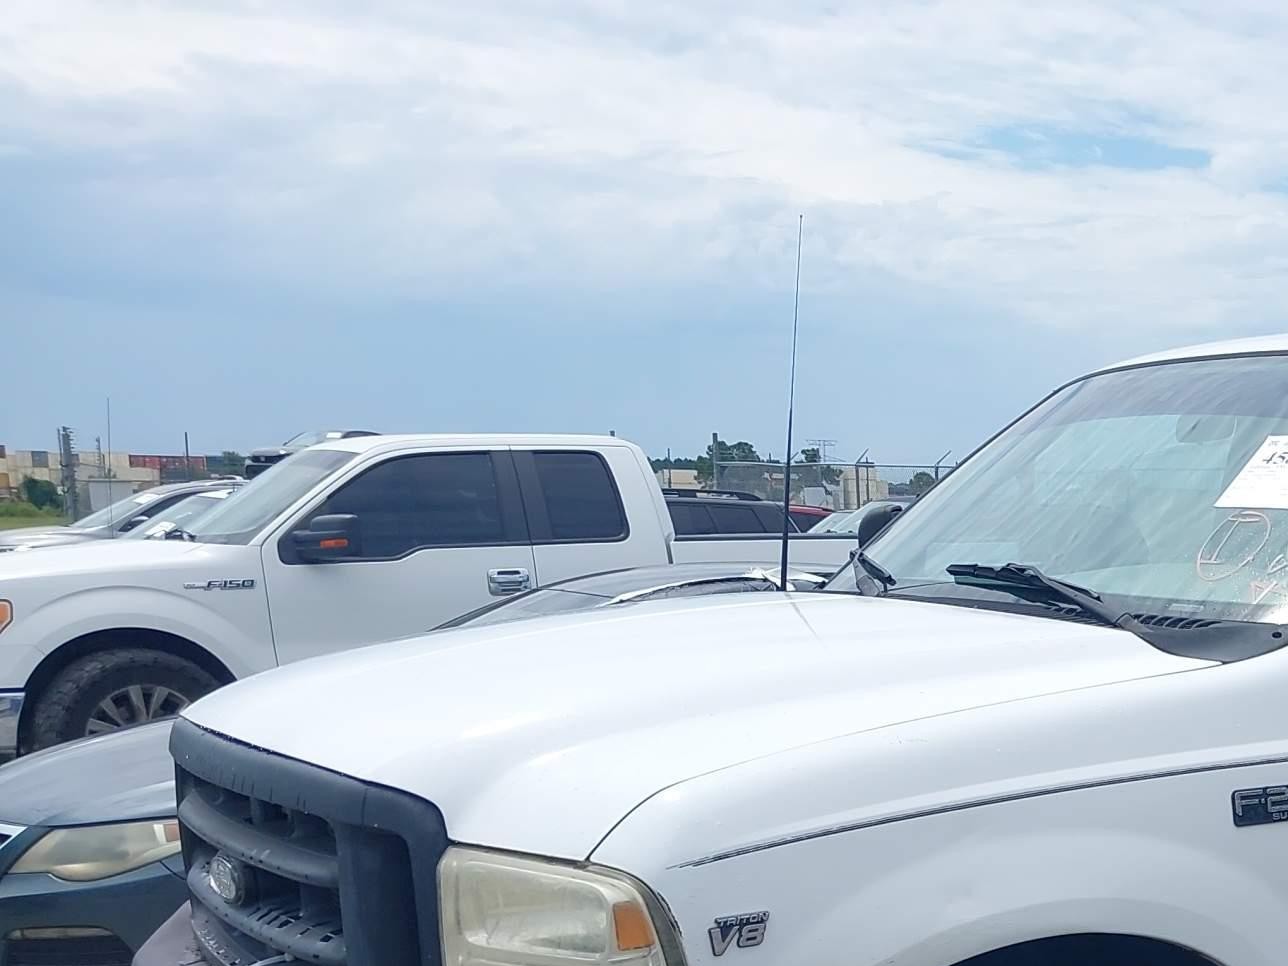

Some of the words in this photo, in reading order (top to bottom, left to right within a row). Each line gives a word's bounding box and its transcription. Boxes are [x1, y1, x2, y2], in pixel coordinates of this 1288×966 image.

[207, 579, 255, 589] F-150
[715, 911, 769, 926] TRITON
[708, 922, 767, 957] V8
